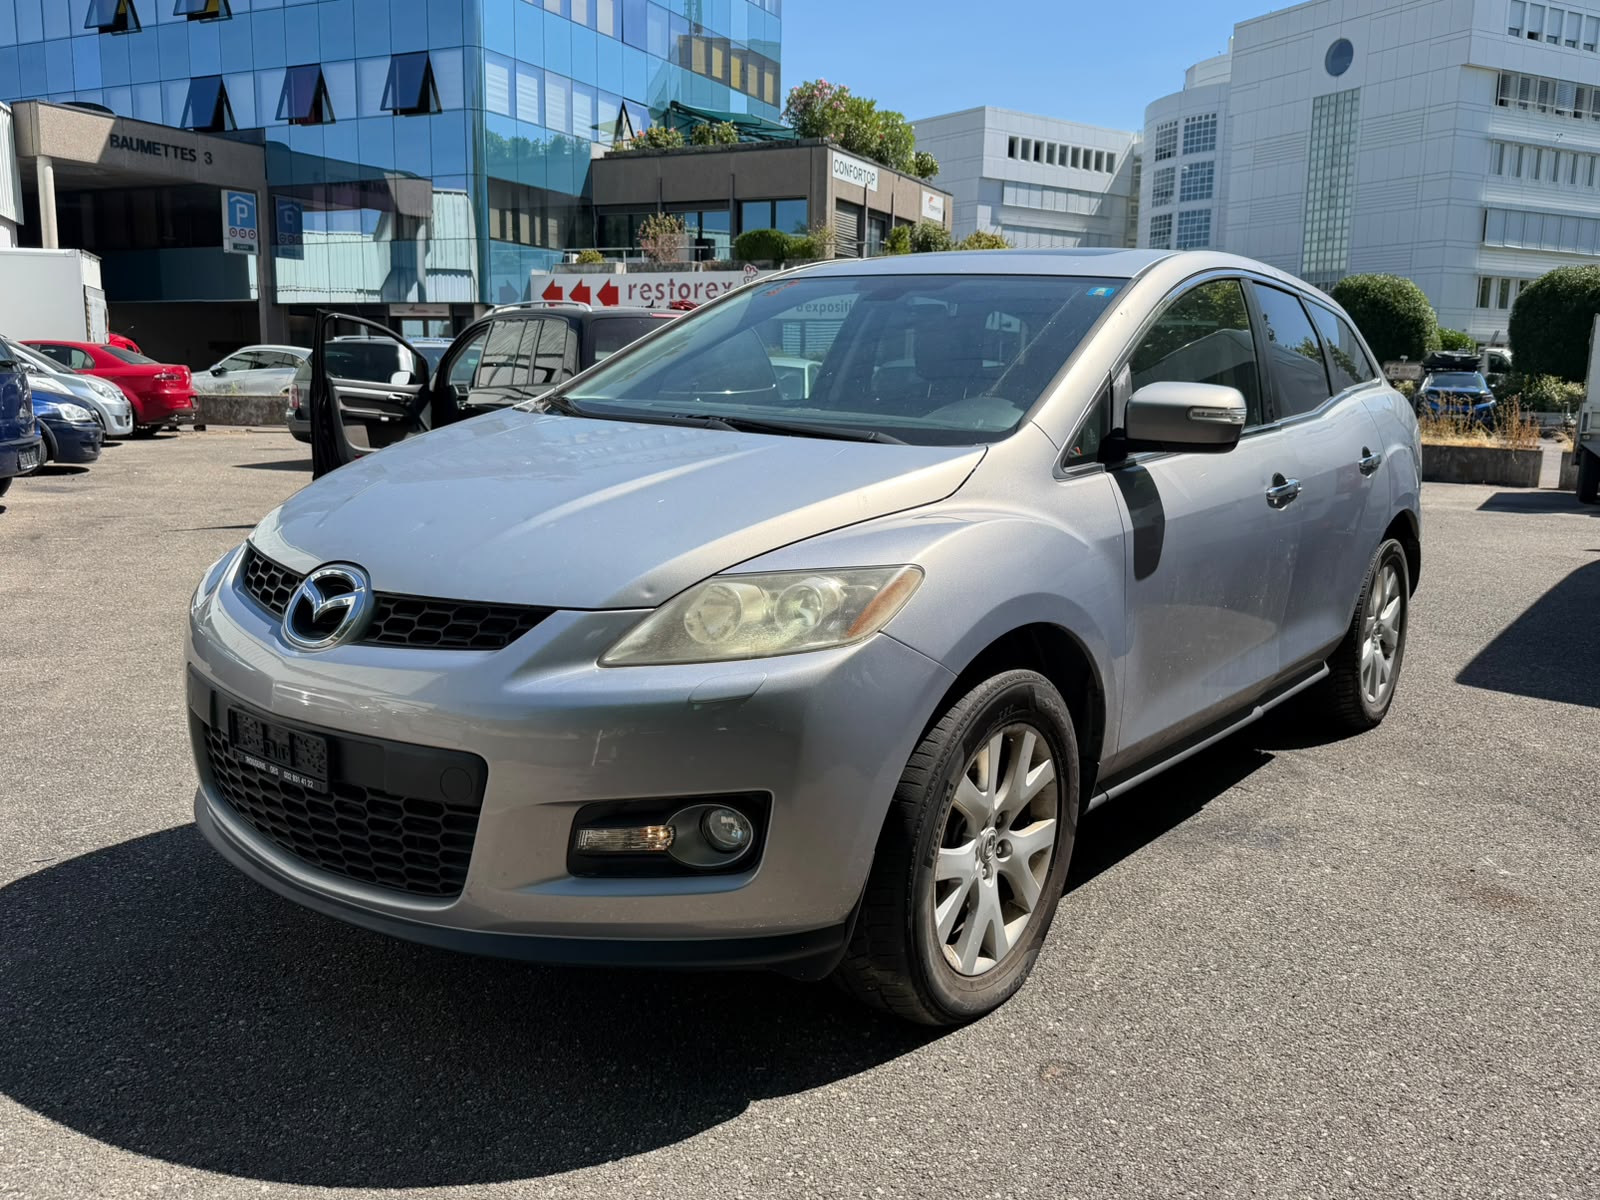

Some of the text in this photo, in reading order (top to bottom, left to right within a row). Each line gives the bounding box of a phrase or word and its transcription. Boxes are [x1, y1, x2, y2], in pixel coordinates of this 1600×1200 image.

[109, 134, 213, 165] BAUMETTES 3
[833, 159, 876, 185] CONFORTOP
[236, 203, 248, 225] P
[627, 278, 733, 300] restorex
